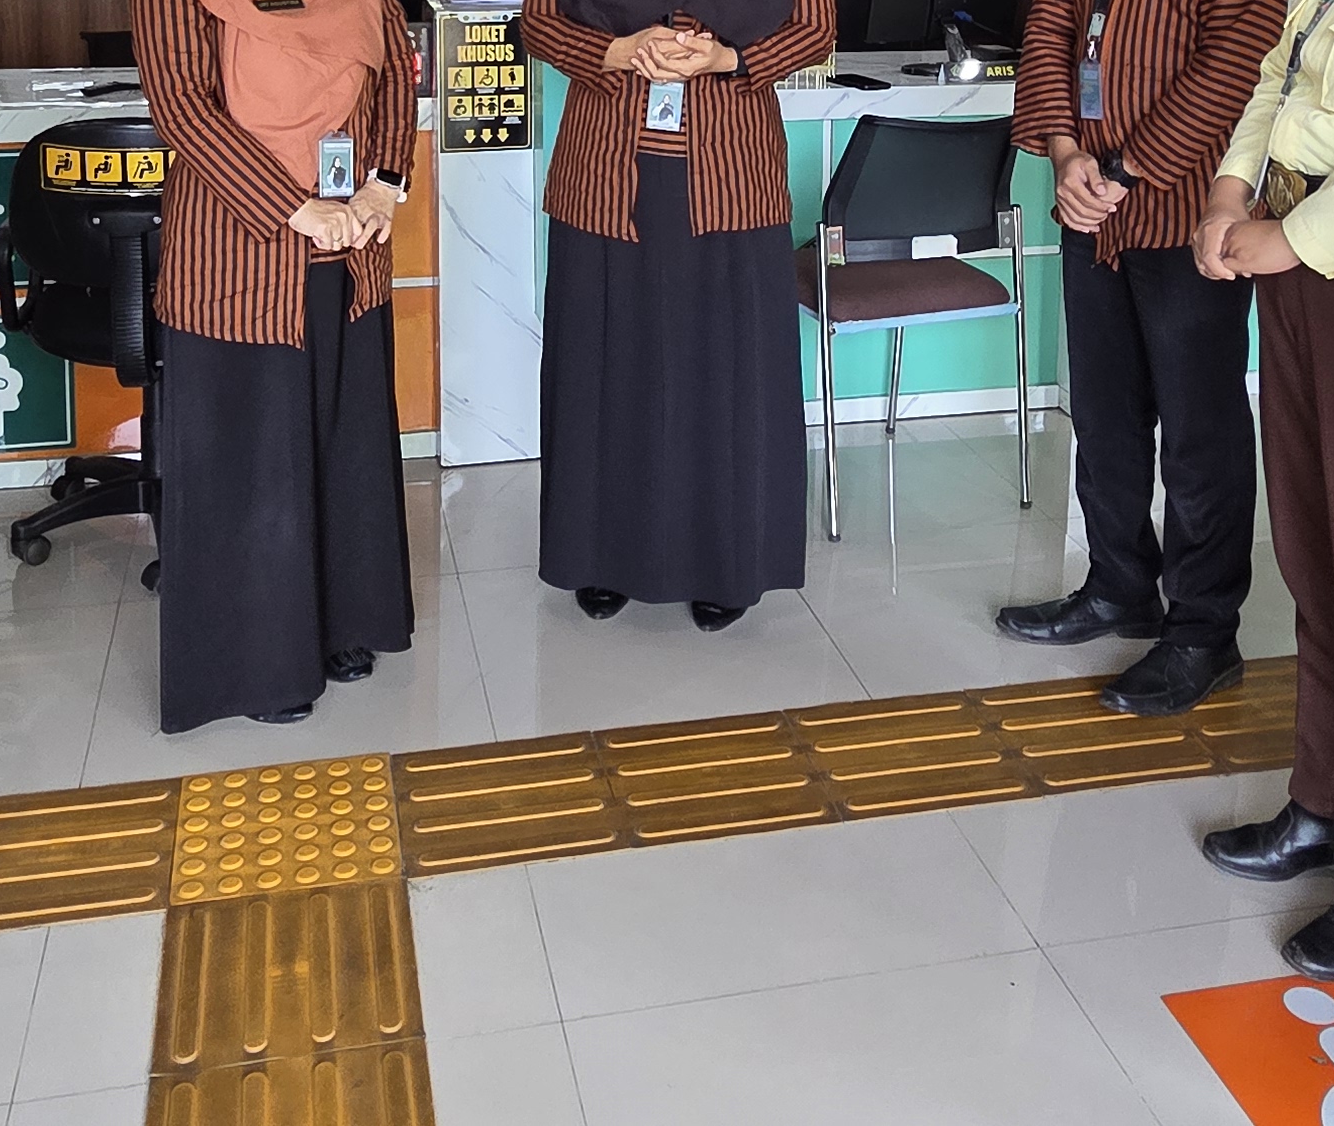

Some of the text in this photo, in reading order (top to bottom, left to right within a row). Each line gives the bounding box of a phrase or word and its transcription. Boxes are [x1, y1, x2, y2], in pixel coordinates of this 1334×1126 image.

[465, 24, 507, 43] LOKET
[457, 44, 514, 63] KHUSUS
[986, 65, 1015, 77] ARIS
